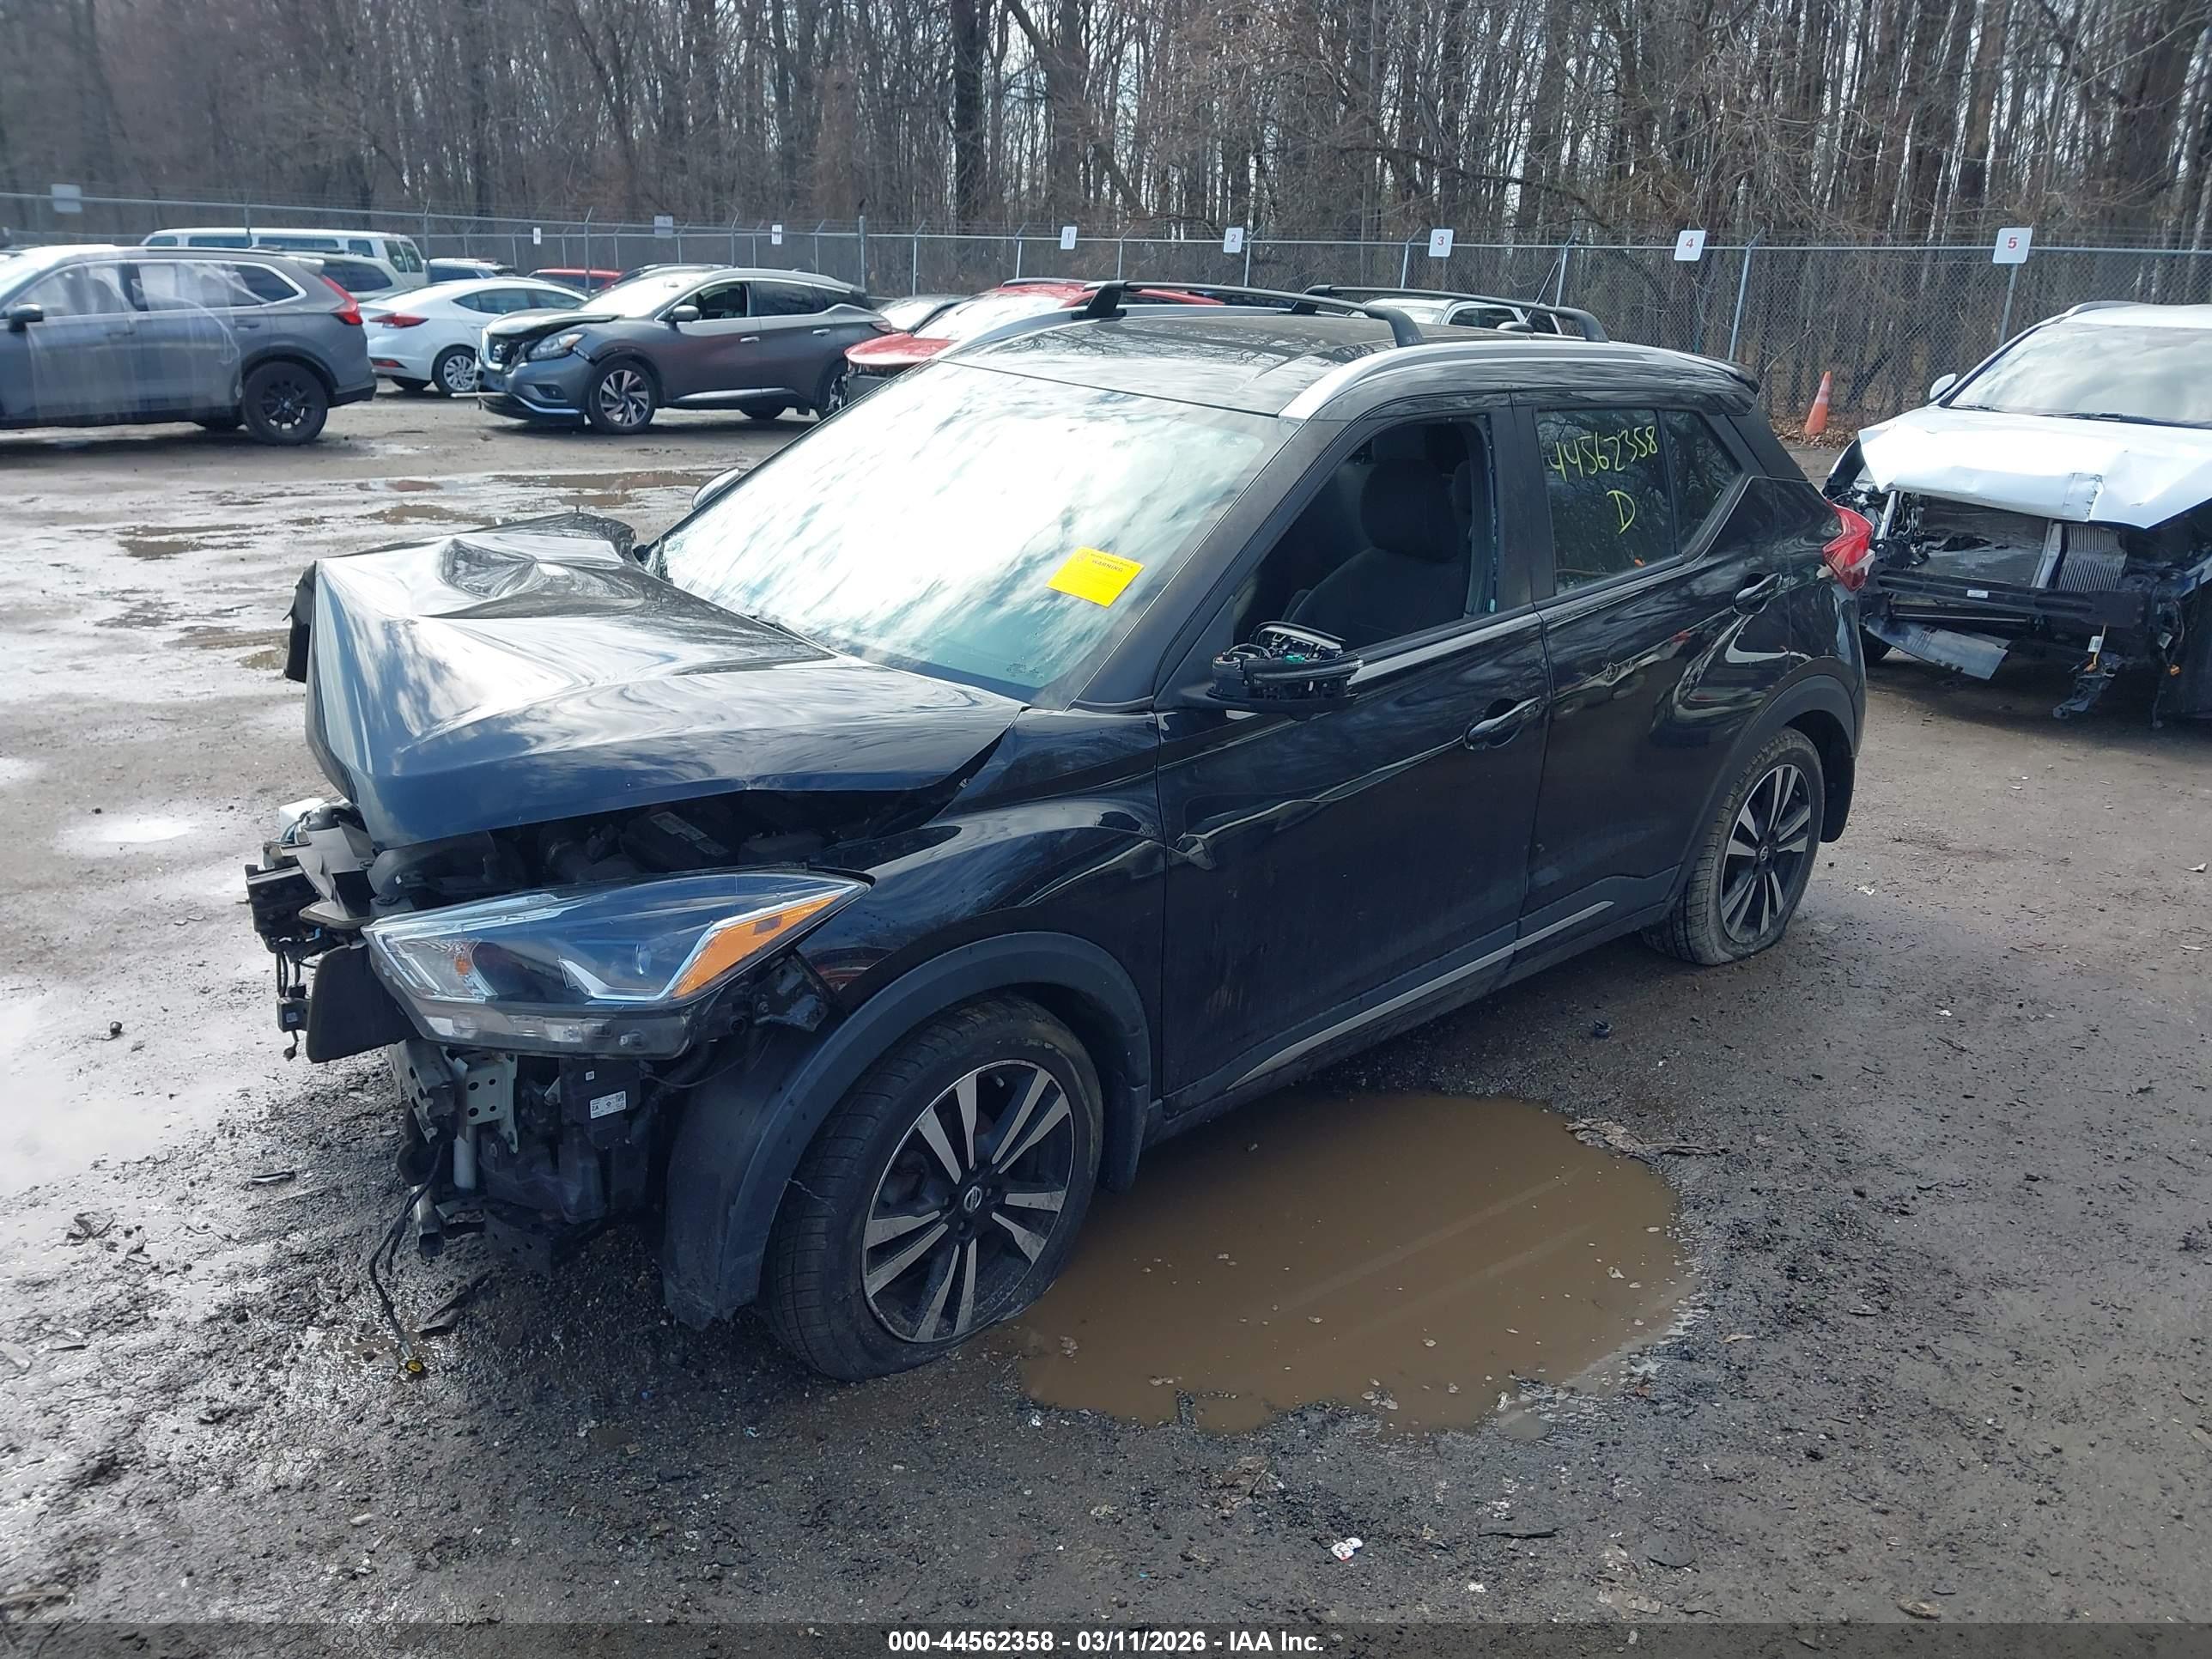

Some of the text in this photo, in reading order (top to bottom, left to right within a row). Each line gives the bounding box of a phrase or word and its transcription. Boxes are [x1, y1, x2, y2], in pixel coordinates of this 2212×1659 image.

[1231, 234, 1237, 243] 2
[1437, 235, 1445, 246] 3
[1686, 238, 1694, 248] 4
[2007, 237, 2018, 249] 5
[1548, 426, 1657, 482] 44562358
[1607, 489, 1635, 534] D
